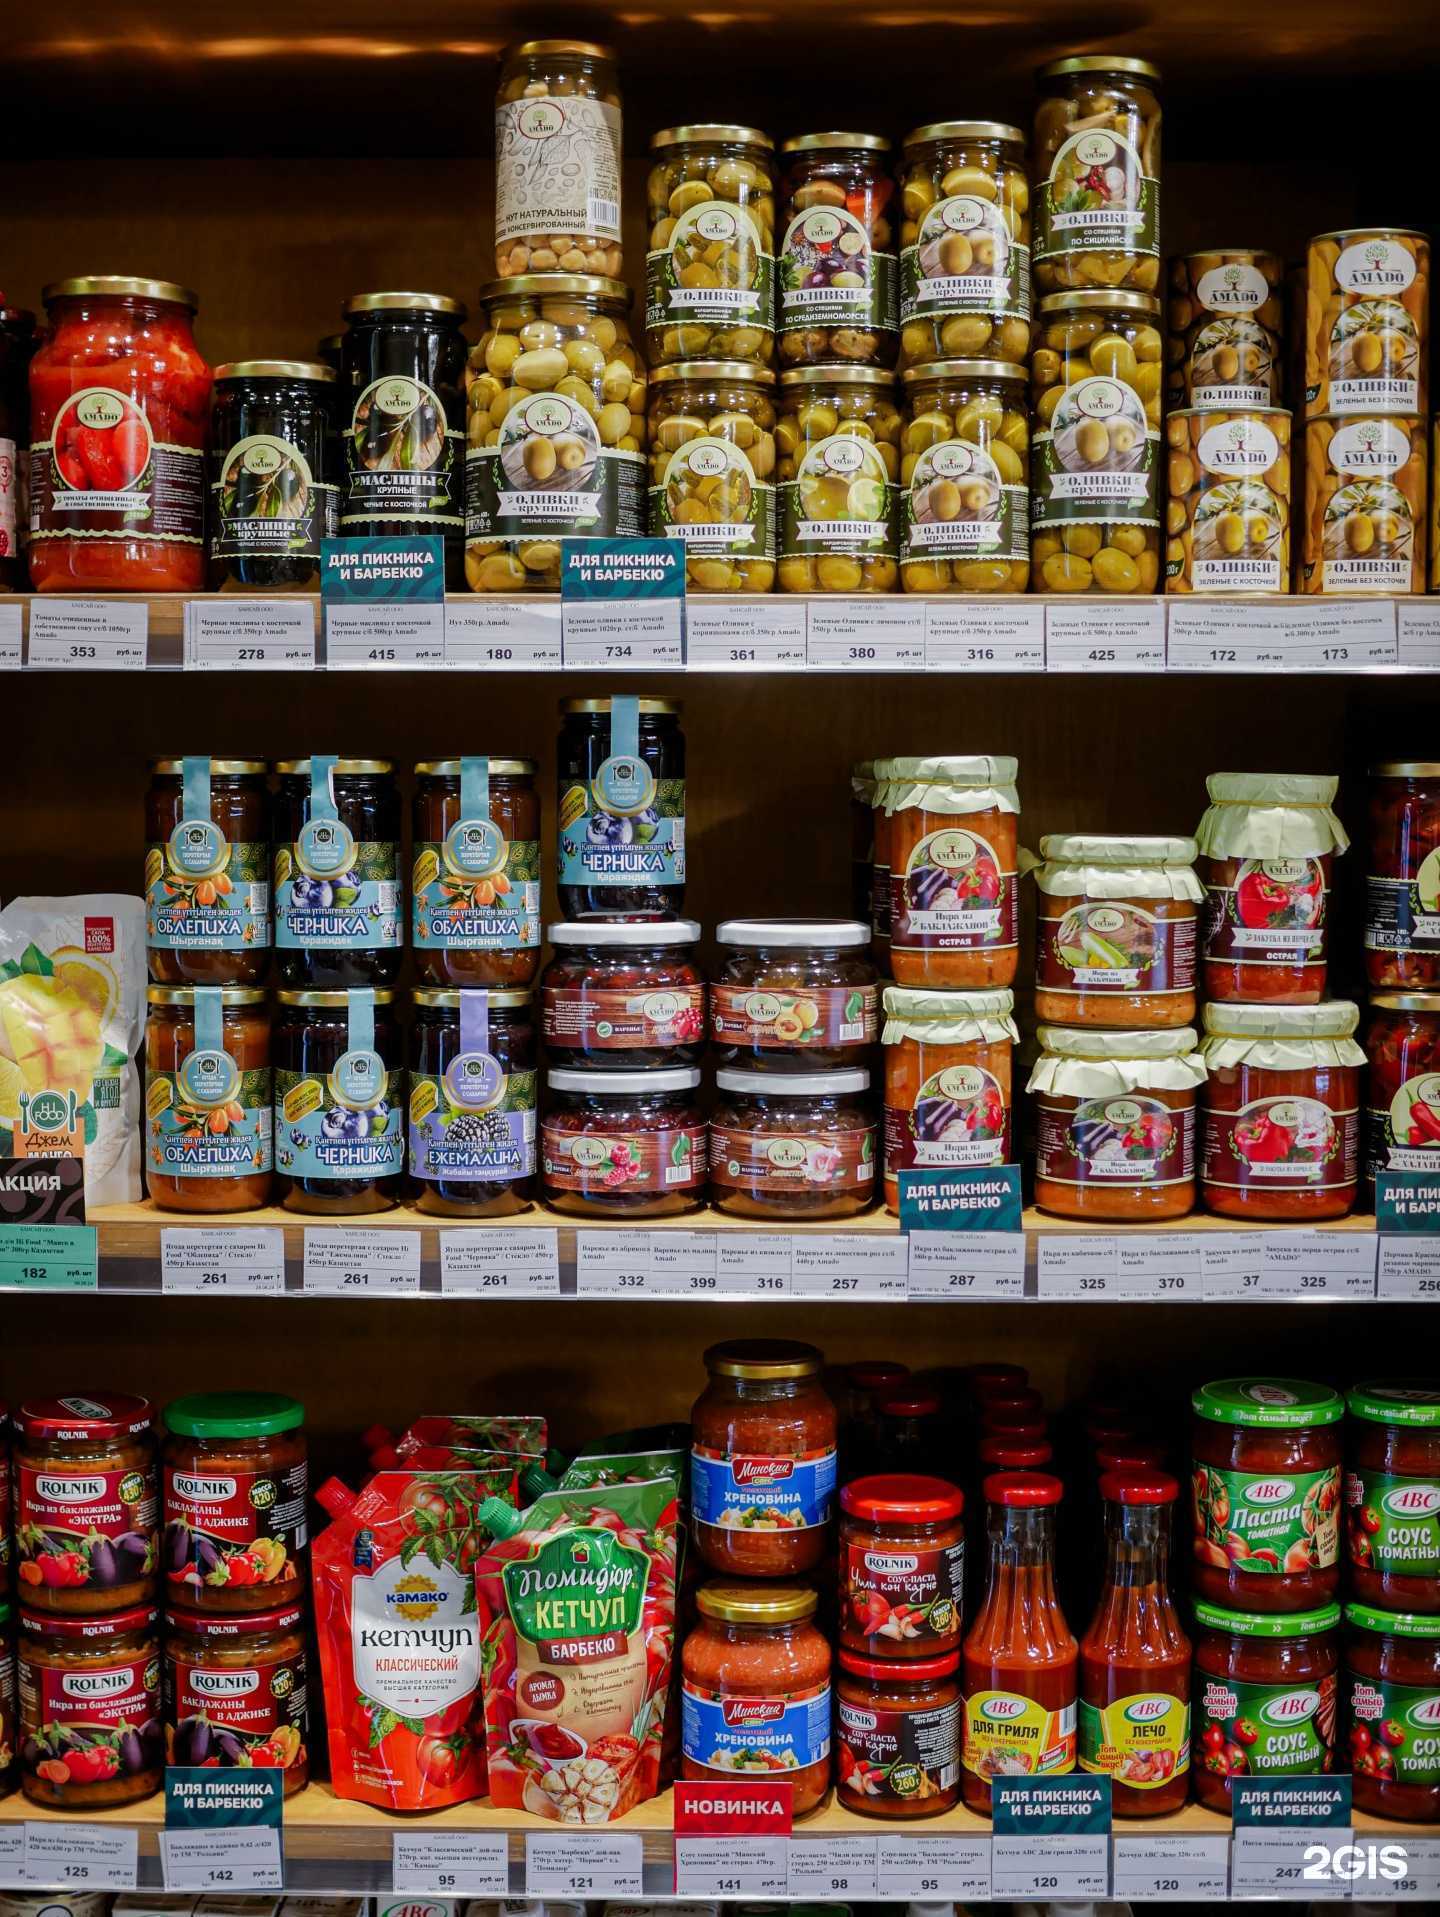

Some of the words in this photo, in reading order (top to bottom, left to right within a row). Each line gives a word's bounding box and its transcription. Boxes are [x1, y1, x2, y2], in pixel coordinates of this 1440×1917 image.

[519, 208, 587, 219] НАТУРАЛЬНЫЙ
[507, 220, 586, 233] КОНСЕРВИРОВАННЫЙ
[1350, 273, 1404, 283] AMADO
[1210, 292, 1258, 302] AMADO
[1341, 382, 1409, 393] ОЛИВКИ
[1203, 390, 1262, 401] ОЛИВКИ
[1212, 452, 1267, 463] AMADO
[360, 475, 437, 487] МАСЛИНЫ
[1068, 475, 1132, 486] ОЛИВКИ
[377, 486, 417, 494] КРУПНЫЕ
[515, 495, 580, 505] ОЛИВКИ
[232, 522, 296, 532] МАСЛИНЫ
[236, 530, 290, 540] крупные
[329, 554, 360, 567] ДЛЯ
[364, 552, 434, 564] ПИКНИКА
[569, 555, 600, 568] ДЛЯ
[603, 554, 675, 567] ПИКНИКА
[340, 569, 351, 580] И
[354, 567, 423, 580] БАРБЕКЮ
[1206, 562, 1271, 573] ОЛИВКИ
[1335, 562, 1400, 573] ОЛИВКИ
[581, 570, 591, 580] И
[595, 568, 665, 581] БАРБЕКЮ
[70, 646, 96, 657] 353
[238, 649, 264, 660] 278
[368, 649, 395, 660] 415
[606, 647, 632, 657] 734
[849, 648, 875, 658] 380
[968, 649, 994, 660] 316
[1088, 650, 1115, 660] 425
[1210, 650, 1236, 661] 172
[1322, 649, 1348, 660] 173
[582, 853, 664, 871] ЧЕРНИКА
[936, 853, 972, 861] AMADO
[936, 912, 960, 921] Икра
[157, 918, 242, 934] ОБЛЕПИХА
[288, 917, 368, 934] ЧЕРНИКА
[432, 919, 519, 935] ОБЛЕПИХА
[920, 922, 989, 931] БАКЛАЖАНОВ
[87, 935, 111, 943] 100%
[939, 938, 971, 946] ОСТРАЯ
[34, 1110, 64, 1121] FOOD
[25, 1133, 73, 1148] Джем
[317, 1146, 394, 1164] ЧЕРНИКА
[429, 1150, 520, 1165] ЕЖЕМАЛИНА
[1384, 1188, 1414, 1201] ДЛЯ
[22, 1268, 47, 1279] 182
[202, 1273, 227, 1284] 261
[483, 1275, 507, 1286] 261
[619, 1276, 644, 1286] 332
[757, 1278, 783, 1289] 316
[833, 1279, 859, 1289] 257
[950, 1275, 976, 1286] 287
[1079, 1278, 1106, 1289] 325
[1158, 1277, 1184, 1289] 370
[57, 1431, 88, 1440] ROLNIK
[41, 1482, 100, 1496] ROLNIK
[176, 1478, 229, 1494] ROLNIK
[1249, 1484, 1288, 1498] ABC
[253, 1493, 271, 1506] 420
[724, 1491, 802, 1505] ХРЕНОВИНА
[1393, 1493, 1436, 1509] ABC
[26, 1500, 46, 1513] Икра
[47, 1505, 58, 1513] из
[59, 1502, 122, 1514] баклажанов
[167, 1500, 222, 1515] БАКЛАЖАНЫ
[68, 1514, 122, 1526] «ЭКСТРА»
[195, 1517, 202, 1526] В
[203, 1517, 249, 1528] АДЖИКЕ
[1231, 1504, 1302, 1529] Паста
[1387, 1528, 1432, 1545] СОУС
[1378, 1546, 1440, 1561] ТОМАТНЫ
[868, 1557, 913, 1569] ROLNIK
[851, 1567, 877, 1590] Чили
[881, 1583, 901, 1591] кон
[905, 1581, 937, 1601] карне
[887, 1575, 936, 1584] СОУС-ПАСТА
[536, 1597, 625, 1629] КЕТЧУП
[551, 1637, 615, 1659] БАРБЕКЮ
[375, 1654, 459, 1672] КЛАССИЧЕСКИЙ
[69, 1675, 128, 1691] ROLNIK
[195, 1675, 252, 1691] ROLNIK
[528, 1680, 556, 1691] АРОМАТ
[1207, 1684, 1227, 1696] Тот
[48, 1698, 73, 1711] Икра
[75, 1702, 87, 1710] из
[88, 1692, 146, 1710] баклажанов
[182, 1696, 245, 1710] БАКЛАЖАНЫ
[1203, 1696, 1236, 1706] самый
[1275, 1697, 1312, 1715] ABC
[98, 1703, 147, 1719] «ЭКСТРА»
[217, 1711, 224, 1720] В
[225, 1708, 272, 1721] АДЖИКЕ
[987, 1702, 1019, 1715] ABC
[1132, 1702, 1166, 1716] ABC
[1208, 1706, 1236, 1718] вкус!
[973, 1720, 996, 1735] ДЛЯ
[998, 1724, 1040, 1738] ГРИЛЯ
[1132, 1725, 1166, 1738] ЛЕЧО
[715, 1732, 794, 1746] ХРЕНОВИНА
[1266, 1732, 1308, 1752] СОУС
[1099, 1744, 1117, 1753] Тот
[1096, 1752, 1124, 1761] самый
[1255, 1746, 1320, 1769] ТОМАТНЫЙ
[173, 1783, 202, 1796] ДЛЯ
[205, 1783, 274, 1795] ПИКНИКА
[896, 1776, 915, 1791] 260
[1001, 1791, 1030, 1803] ДЛЯ
[1033, 1790, 1102, 1802] ПИКНИКА
[184, 1798, 194, 1808] И
[197, 1797, 263, 1809] БАРБЕКЮ
[684, 1800, 784, 1815] НОВИНКА
[1012, 1805, 1022, 1815] И
[1025, 1804, 1092, 1816] БАРБЕКЮ
[64, 1866, 89, 1878] 125
[208, 1870, 233, 1881] 142
[1276, 1867, 1301, 1878] 247
[438, 1875, 456, 1885] 95
[569, 1877, 593, 1888] 121
[717, 1879, 742, 1890] 141
[831, 1878, 848, 1889] 98
[1032, 1877, 1058, 1888] 120
[1393, 1880, 1418, 1891] 195
